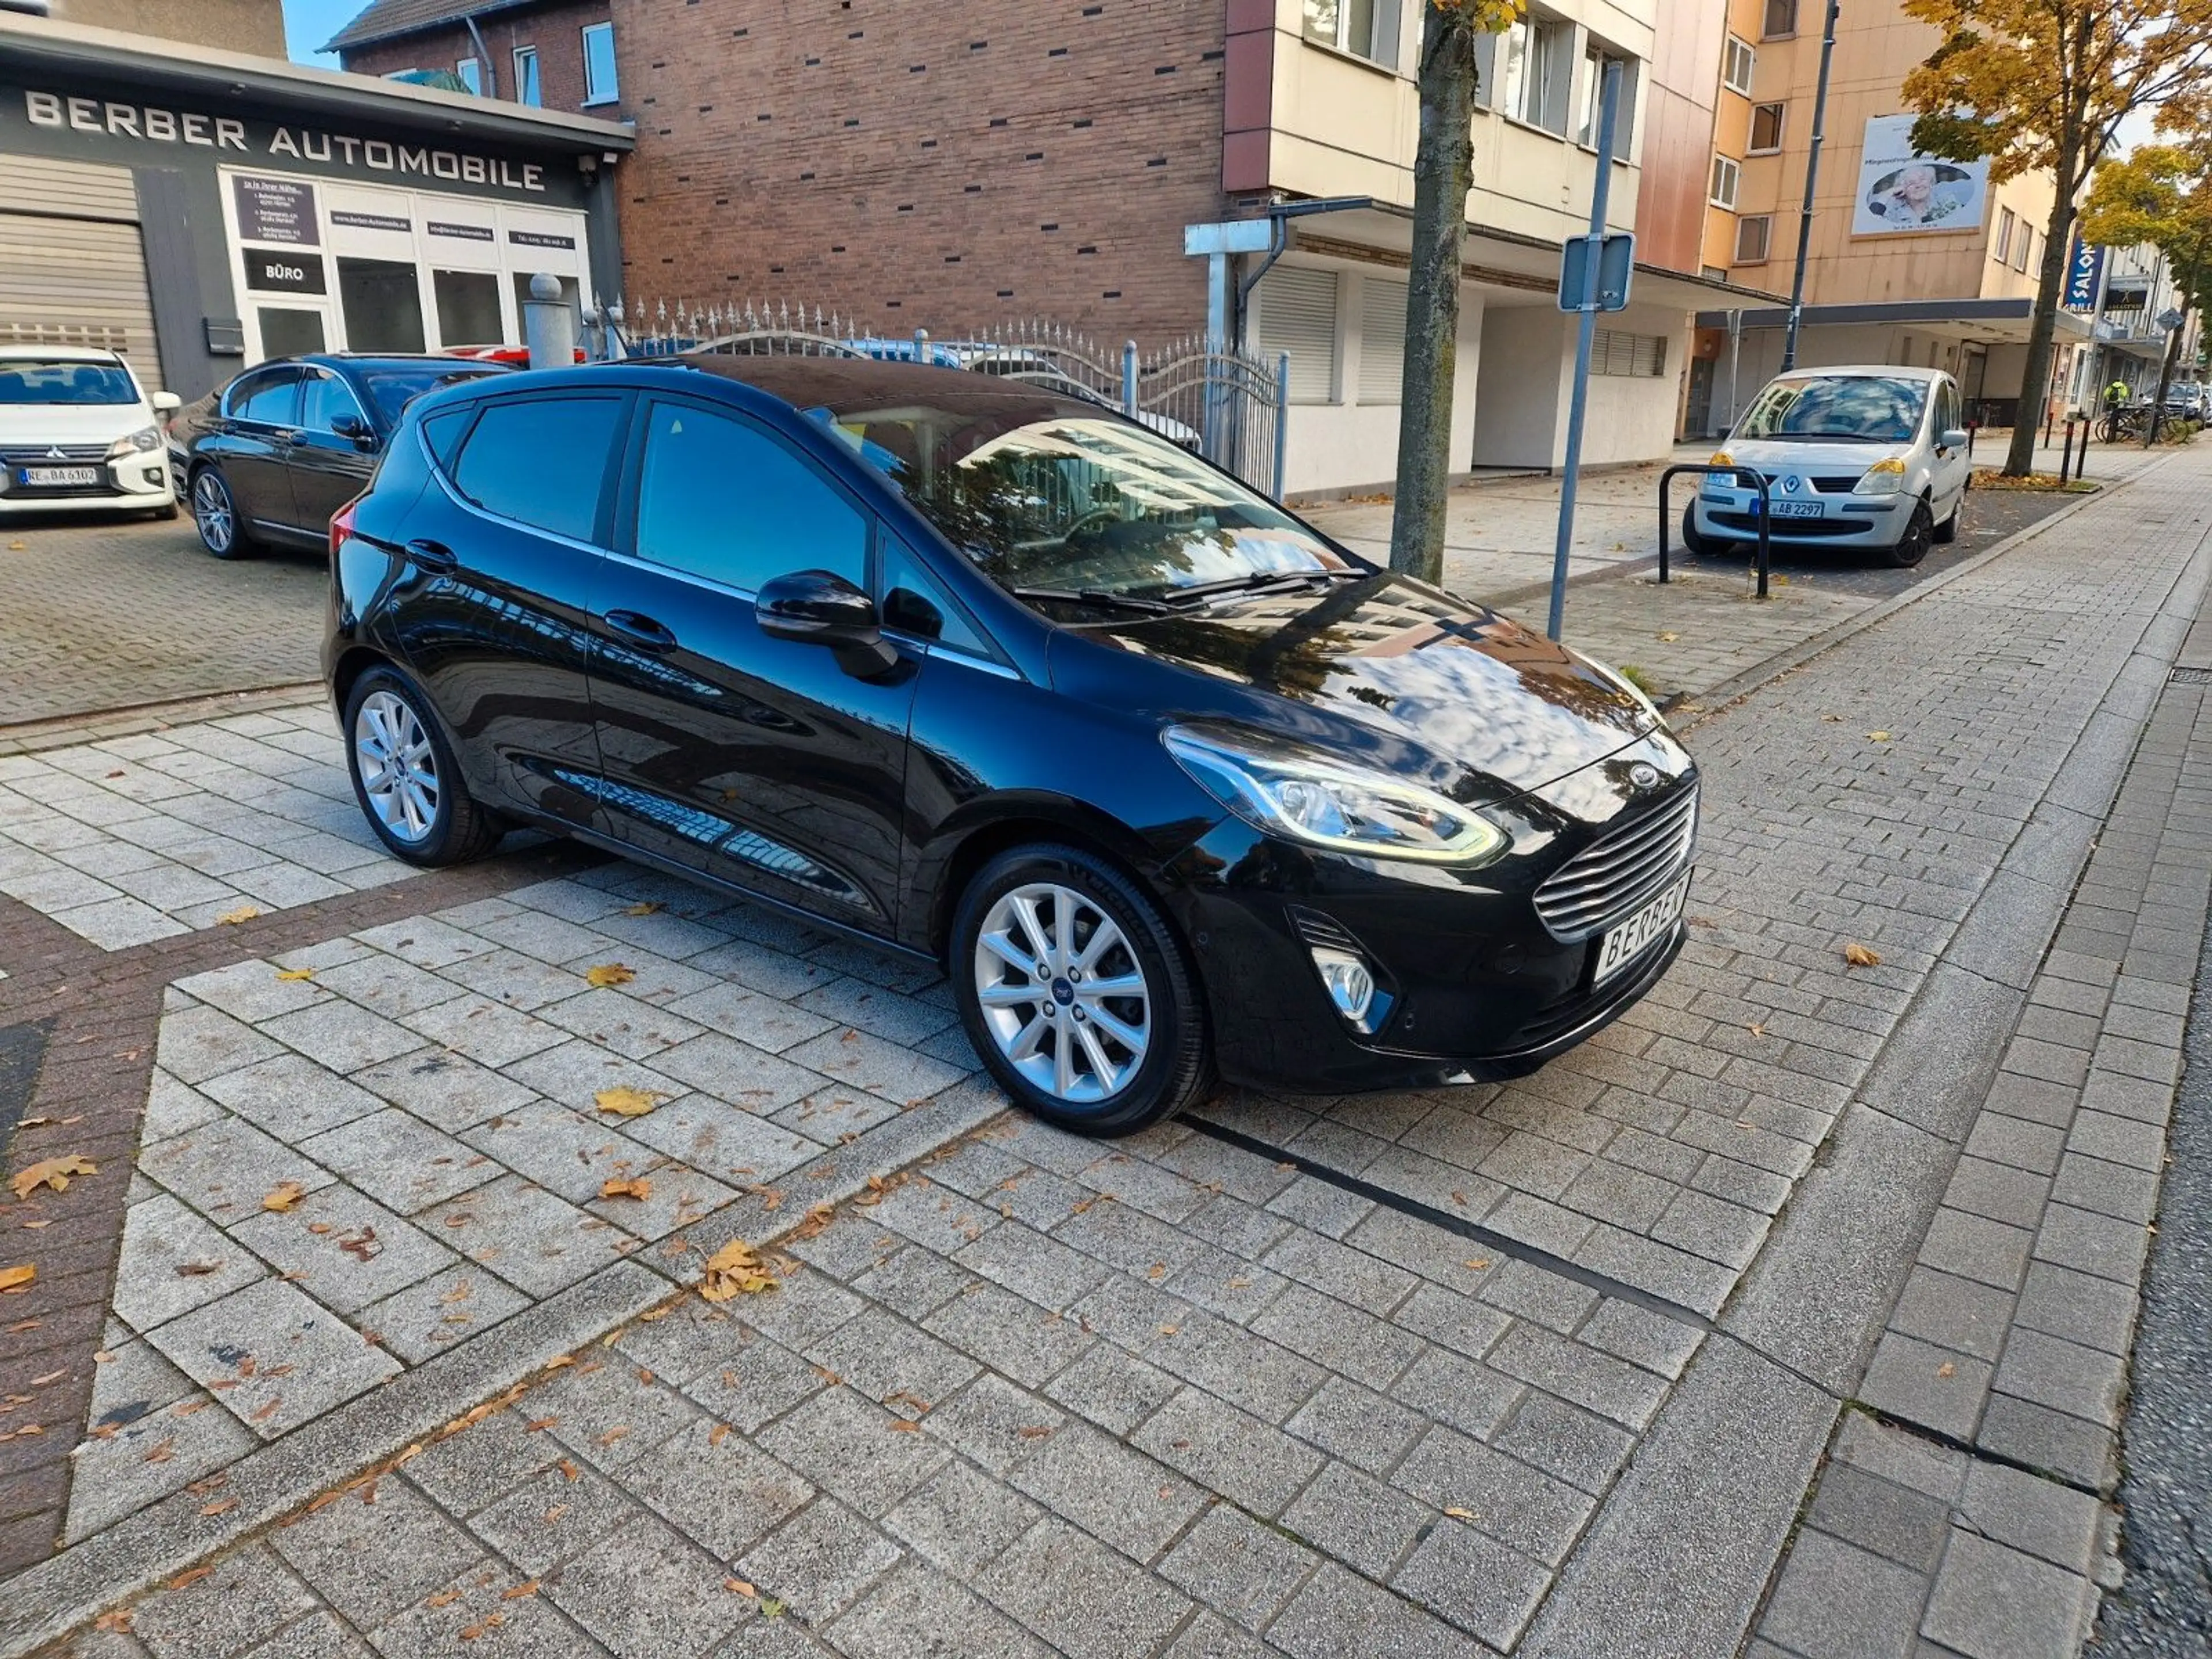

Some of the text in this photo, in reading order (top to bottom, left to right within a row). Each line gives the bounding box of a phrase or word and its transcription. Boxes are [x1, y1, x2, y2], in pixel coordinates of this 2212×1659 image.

[25, 90, 545, 191] BERBER AUTOMOBILE
[266, 263, 304, 280] BÜRO
[1779, 503, 1820, 515] AB 2297
[1605, 880, 1684, 968] BERBER
